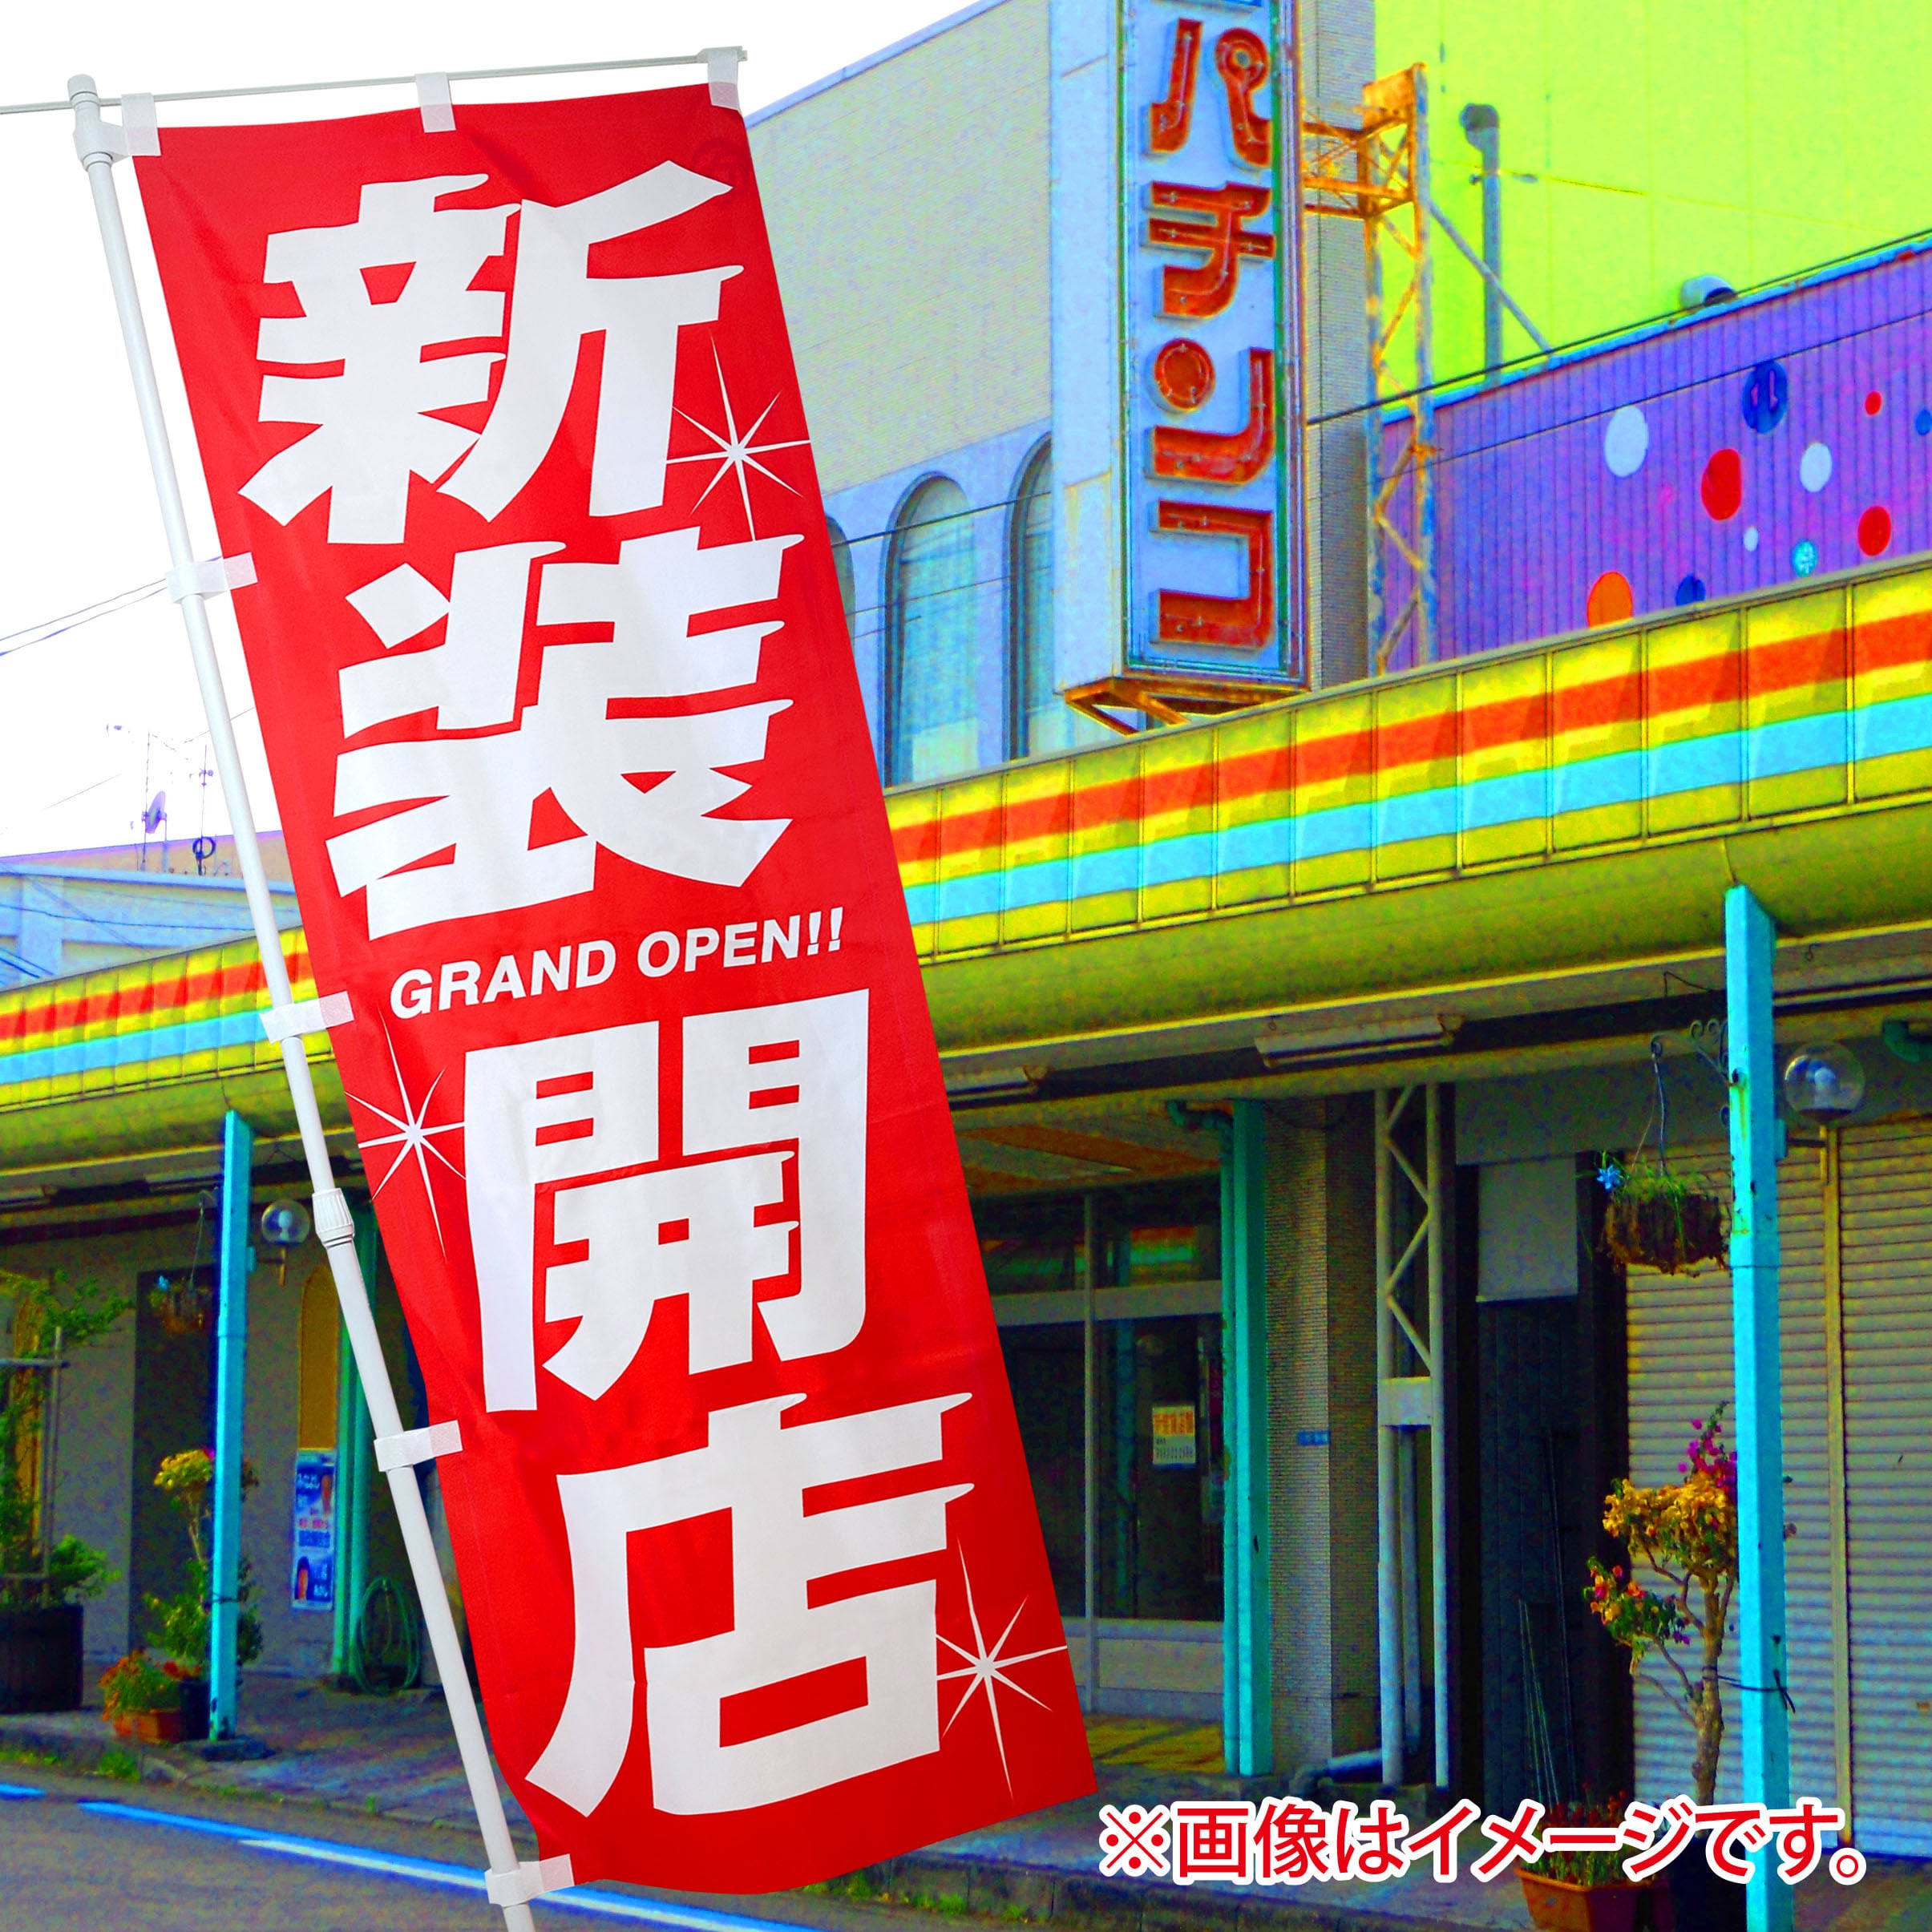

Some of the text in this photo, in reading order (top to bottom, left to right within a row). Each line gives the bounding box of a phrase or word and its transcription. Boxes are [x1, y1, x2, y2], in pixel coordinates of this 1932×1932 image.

[1146, 18, 1276, 651] パチンコ
[389, 907, 845, 1020] GRAND OPEN!!
